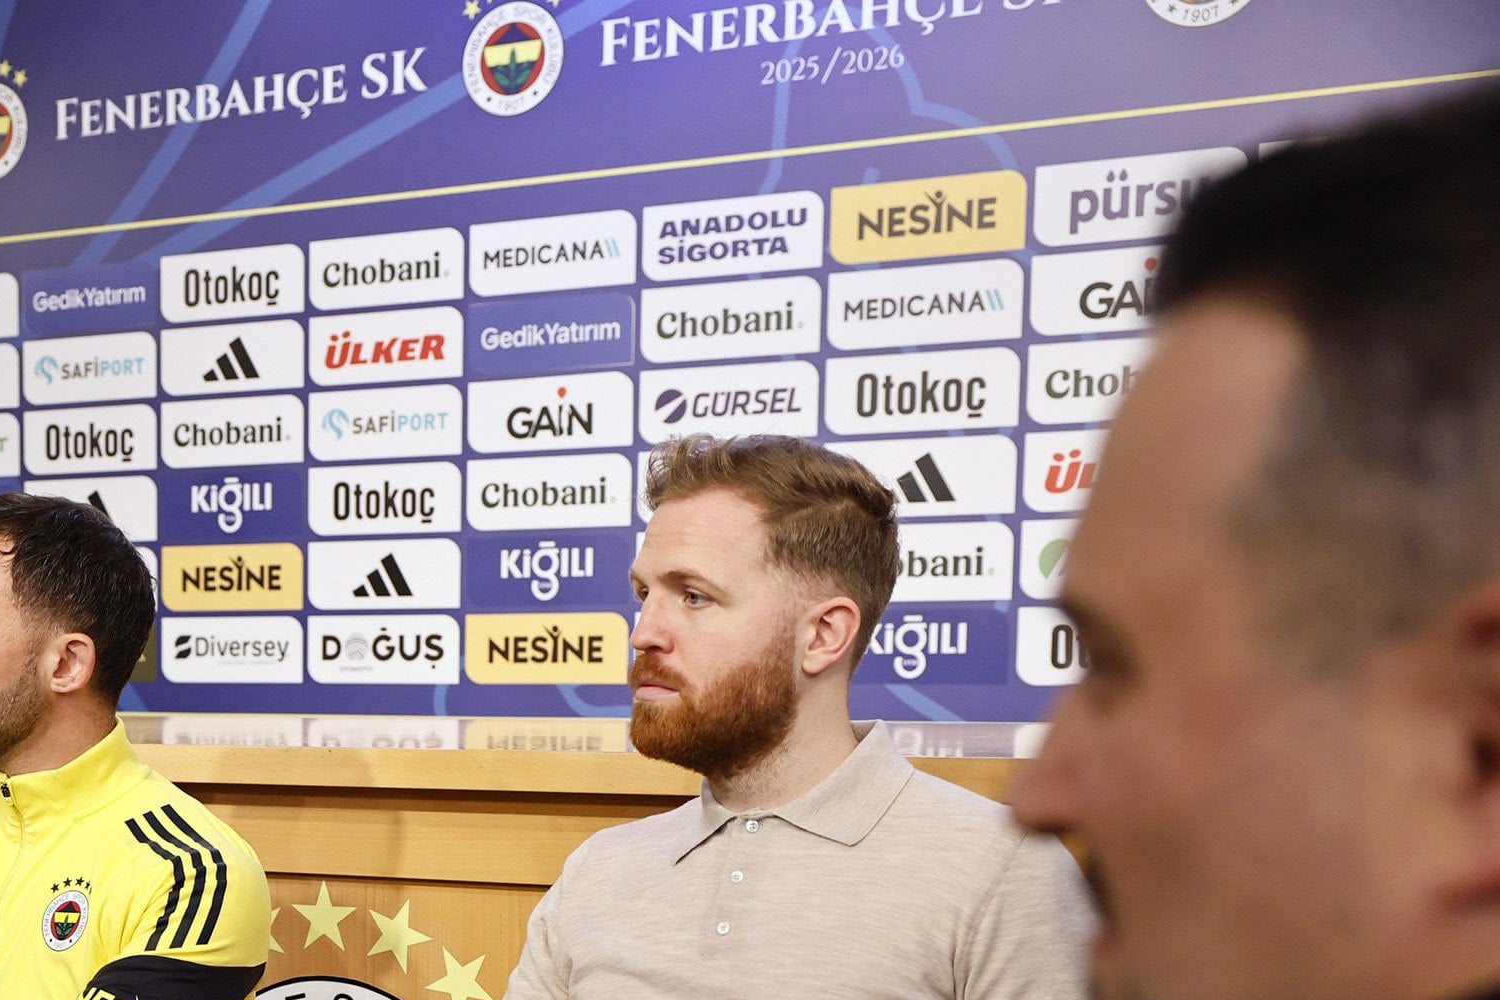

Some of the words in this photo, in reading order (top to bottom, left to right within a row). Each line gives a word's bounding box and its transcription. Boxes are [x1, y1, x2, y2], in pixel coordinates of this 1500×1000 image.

[761, 45, 905, 86] 2025/2026
[56, 62, 347, 141] FENERBAHÇE
[361, 47, 427, 97] SK
[659, 208, 808, 239] ANADOLU
[483, 240, 604, 269] MEDICANA
[658, 237, 789, 265] SİGORTA
[184, 267, 279, 307] Otokoç
[323, 252, 440, 289] Chobani
[656, 301, 794, 339] Chobani
[844, 290, 985, 321] MEDICANA
[325, 331, 445, 369] ÜLKER
[692, 388, 802, 418] GÜRSEL
[857, 371, 986, 418] Otokoç
[45, 423, 134, 462] Otokoç
[174, 417, 282, 447] Chobani
[333, 481, 435, 523] Otokoç
[481, 477, 606, 509] Chobani
[195, 636, 289, 662] Diversey
